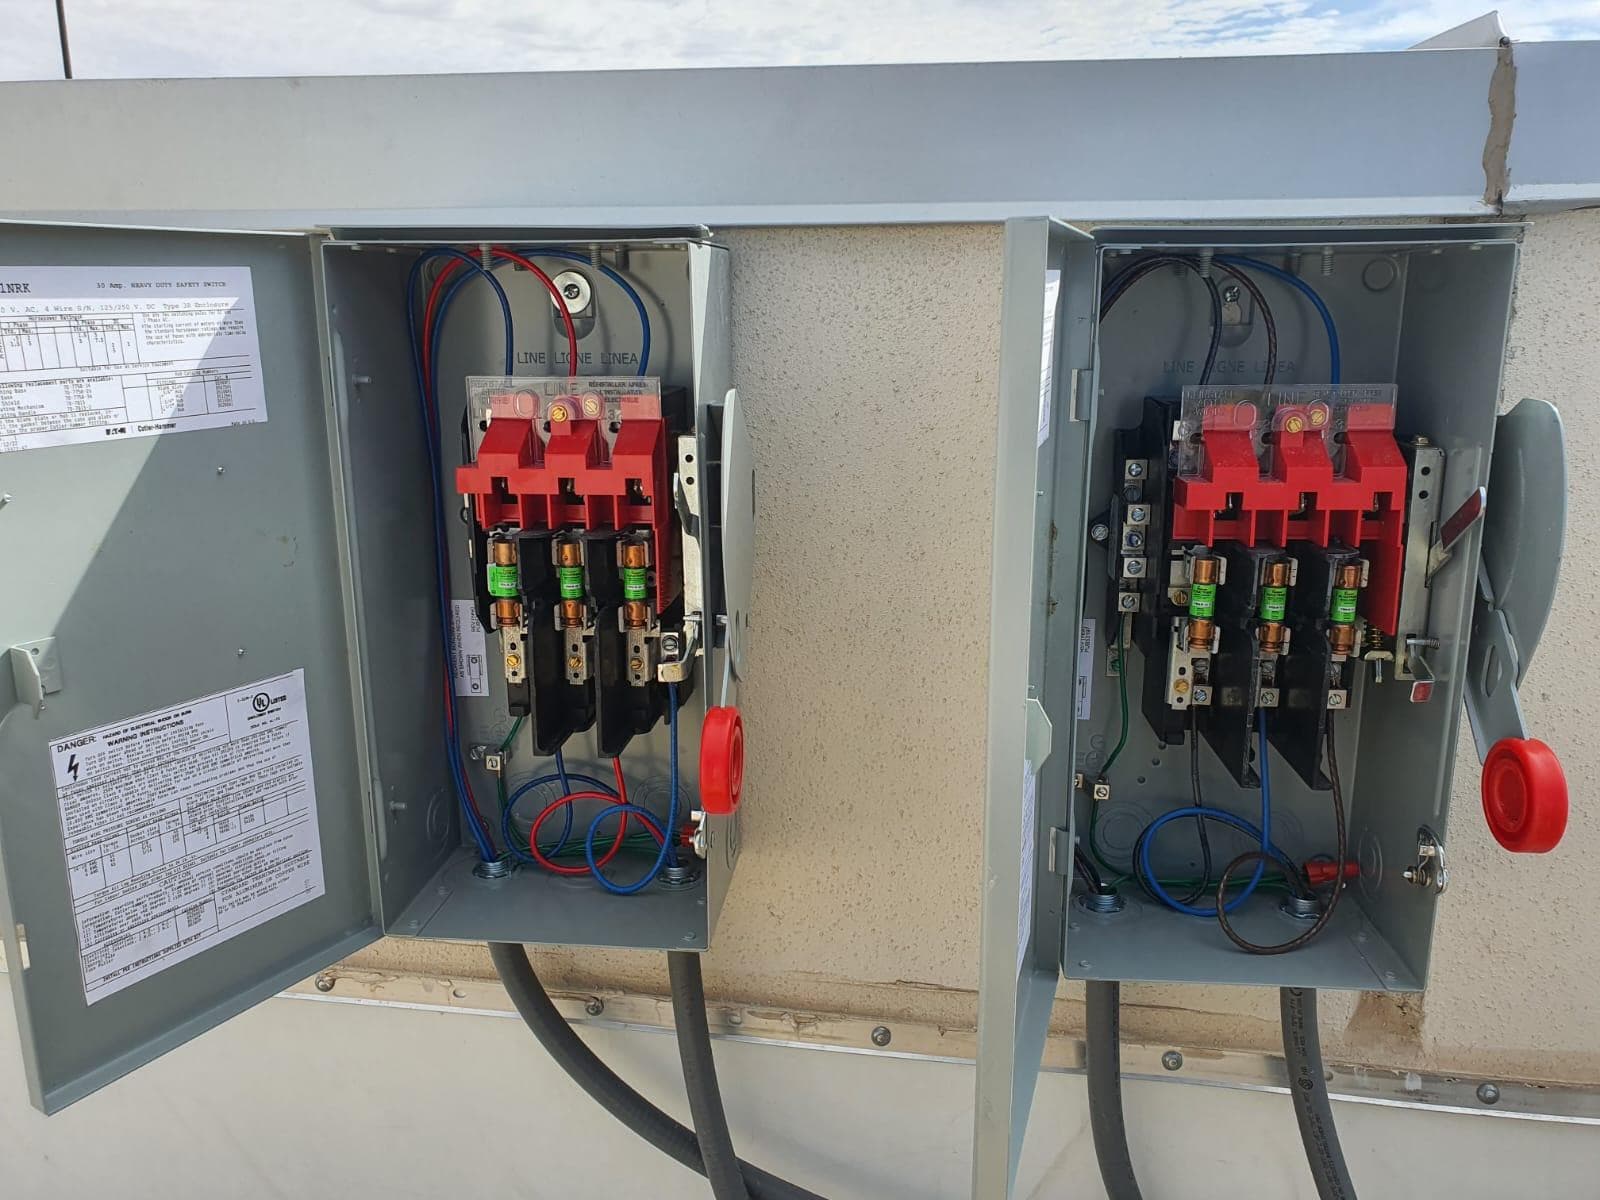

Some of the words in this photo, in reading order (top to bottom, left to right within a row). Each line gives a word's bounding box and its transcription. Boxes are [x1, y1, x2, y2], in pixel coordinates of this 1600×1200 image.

[518, 352, 546, 364] LINE
[600, 352, 638, 364] LINEA
[544, 382, 577, 396] LINE
[138, 422, 176, 432] Cutler-Hammer
[107, 733, 137, 747] WARNING
[140, 719, 183, 737] INSTRUCTIONS
[158, 869, 191, 887] CAUTION
